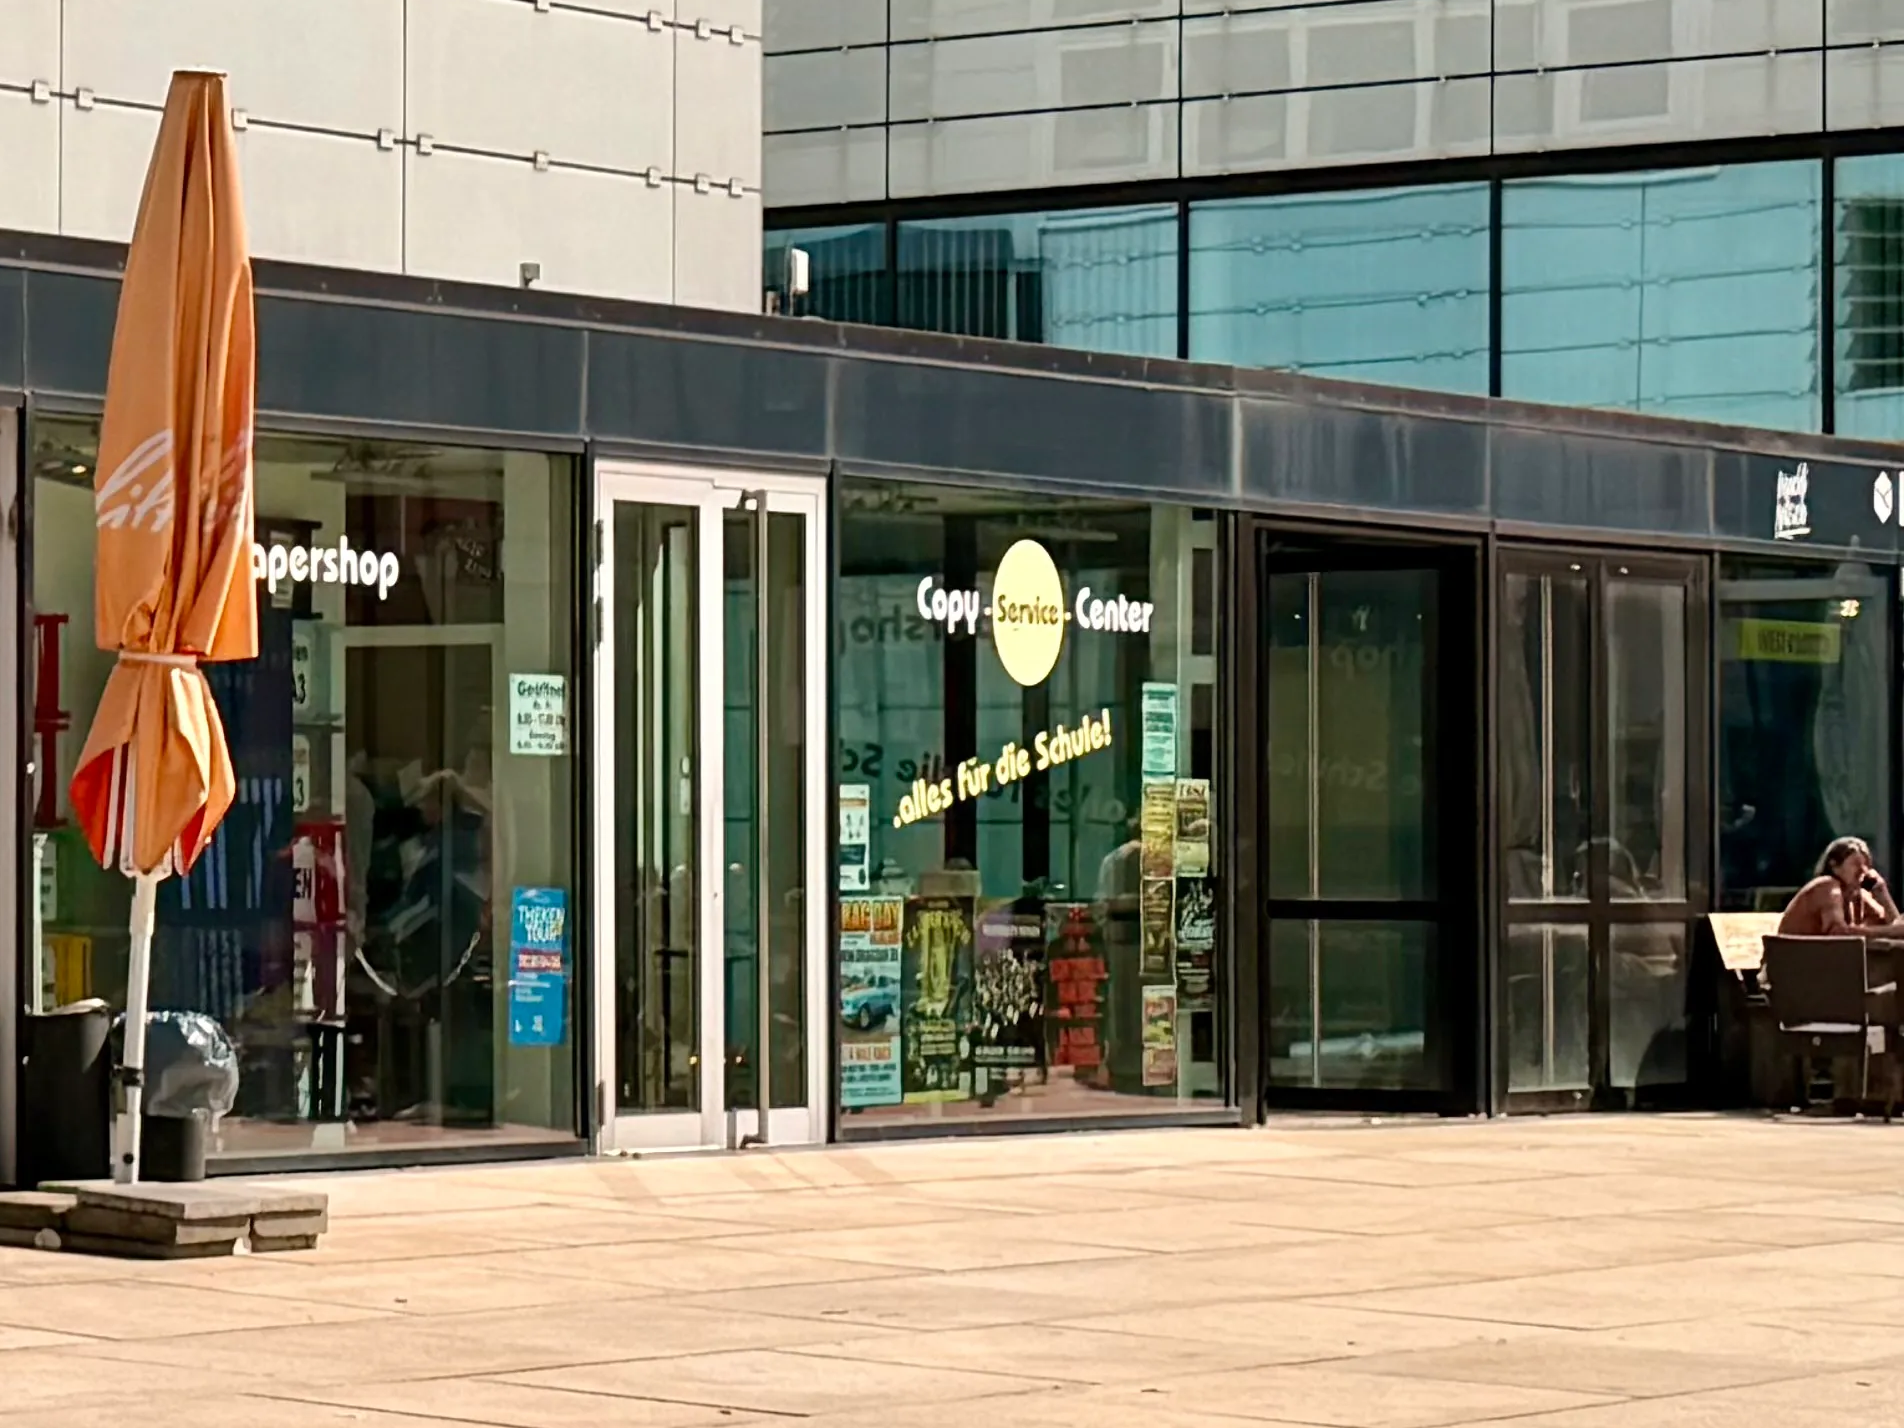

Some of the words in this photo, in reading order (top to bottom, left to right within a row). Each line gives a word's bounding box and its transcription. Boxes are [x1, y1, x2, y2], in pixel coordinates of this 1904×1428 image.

[917, 575, 981, 636] Copy
[997, 593, 1060, 626] Service
[1075, 586, 1155, 633] Center
[957, 755, 992, 802] für
[995, 741, 1032, 786] die
[1034, 707, 1113, 772] Schule!
